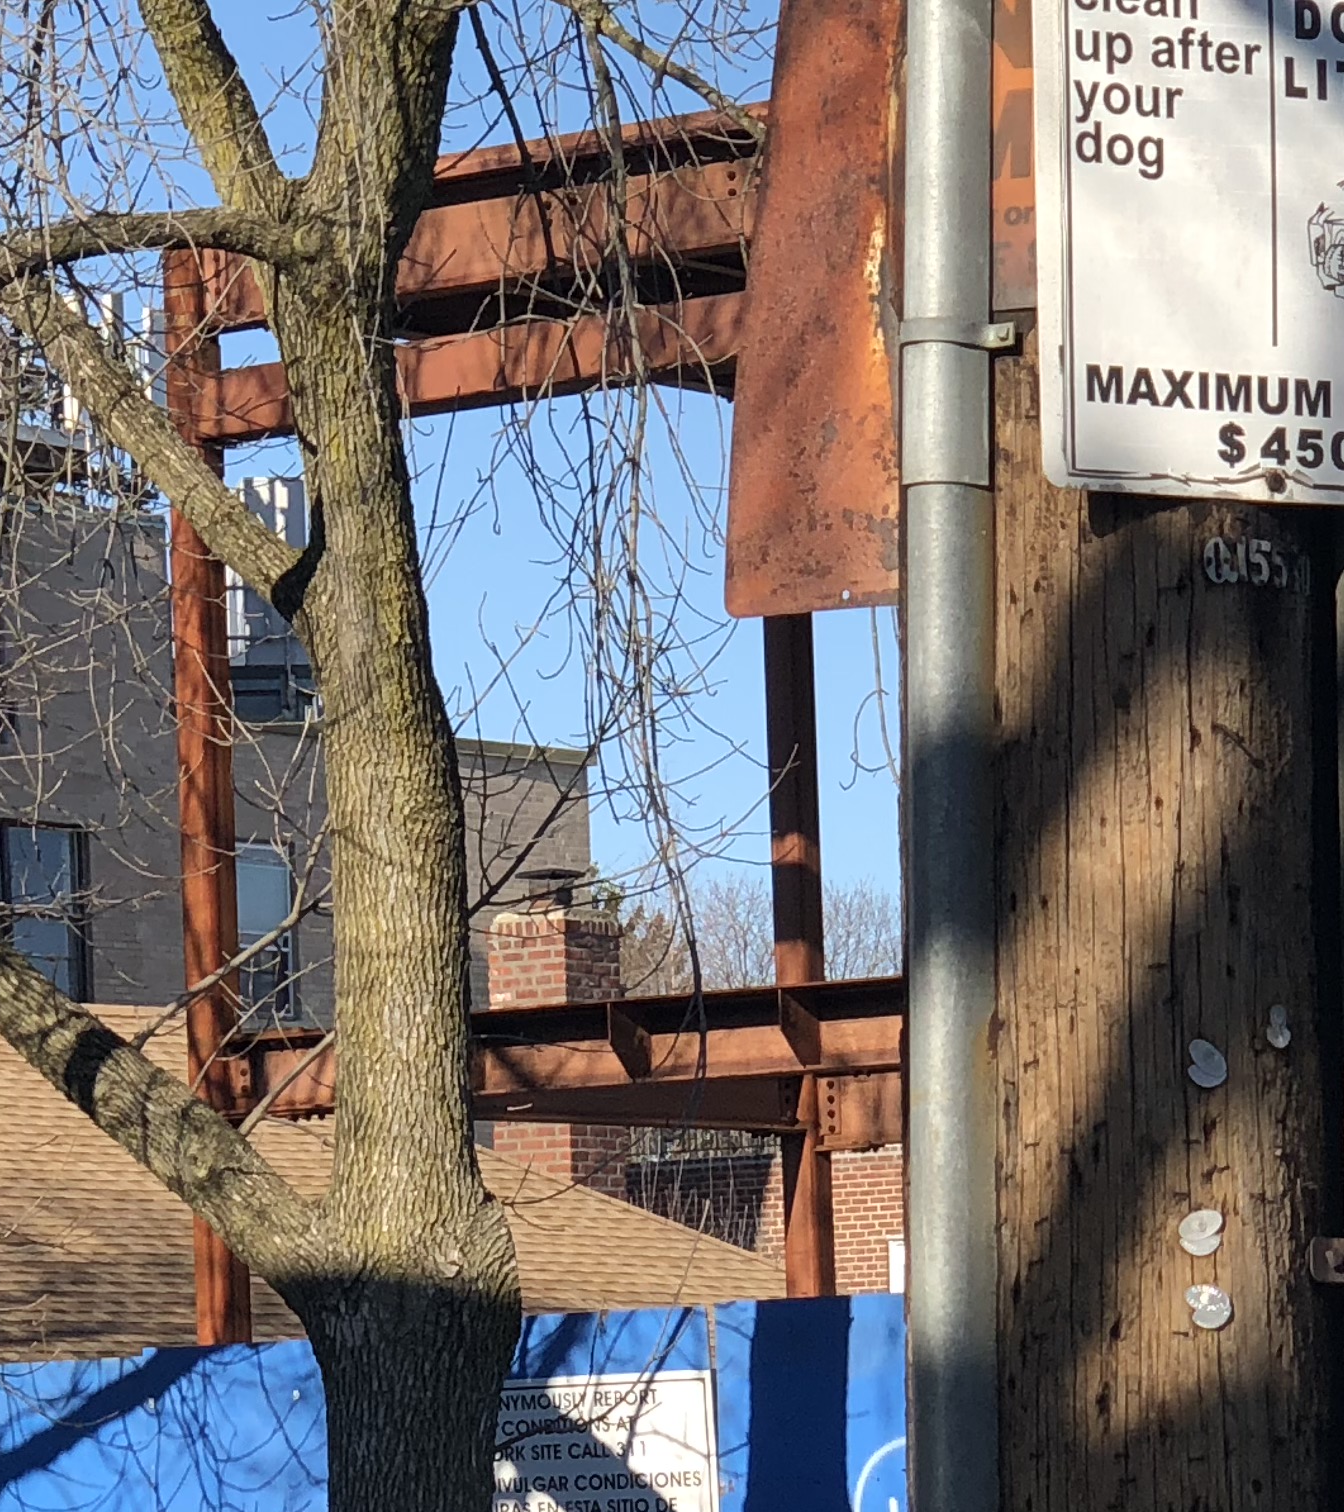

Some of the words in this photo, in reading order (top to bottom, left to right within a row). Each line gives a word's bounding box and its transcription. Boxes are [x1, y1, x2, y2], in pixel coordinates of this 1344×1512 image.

[1074, 29, 1133, 74] up
[1151, 27, 1262, 75] after
[1073, 79, 1184, 124] your
[1074, 121, 1165, 179] dog
[1085, 364, 1331, 419] MAXIMUM
[499, 1392, 585, 1411] NYMOUSLY
[594, 1389, 657, 1407] REPORT
[616, 1415, 635, 1432] AT
[493, 1446, 525, 1462] ORK
[531, 1444, 562, 1460] SITE
[568, 1442, 611, 1459] CALL
[616, 1441, 647, 1458] 311
[494, 1476, 568, 1493] IVULGAR
[574, 1471, 702, 1491] CONDICIONES
